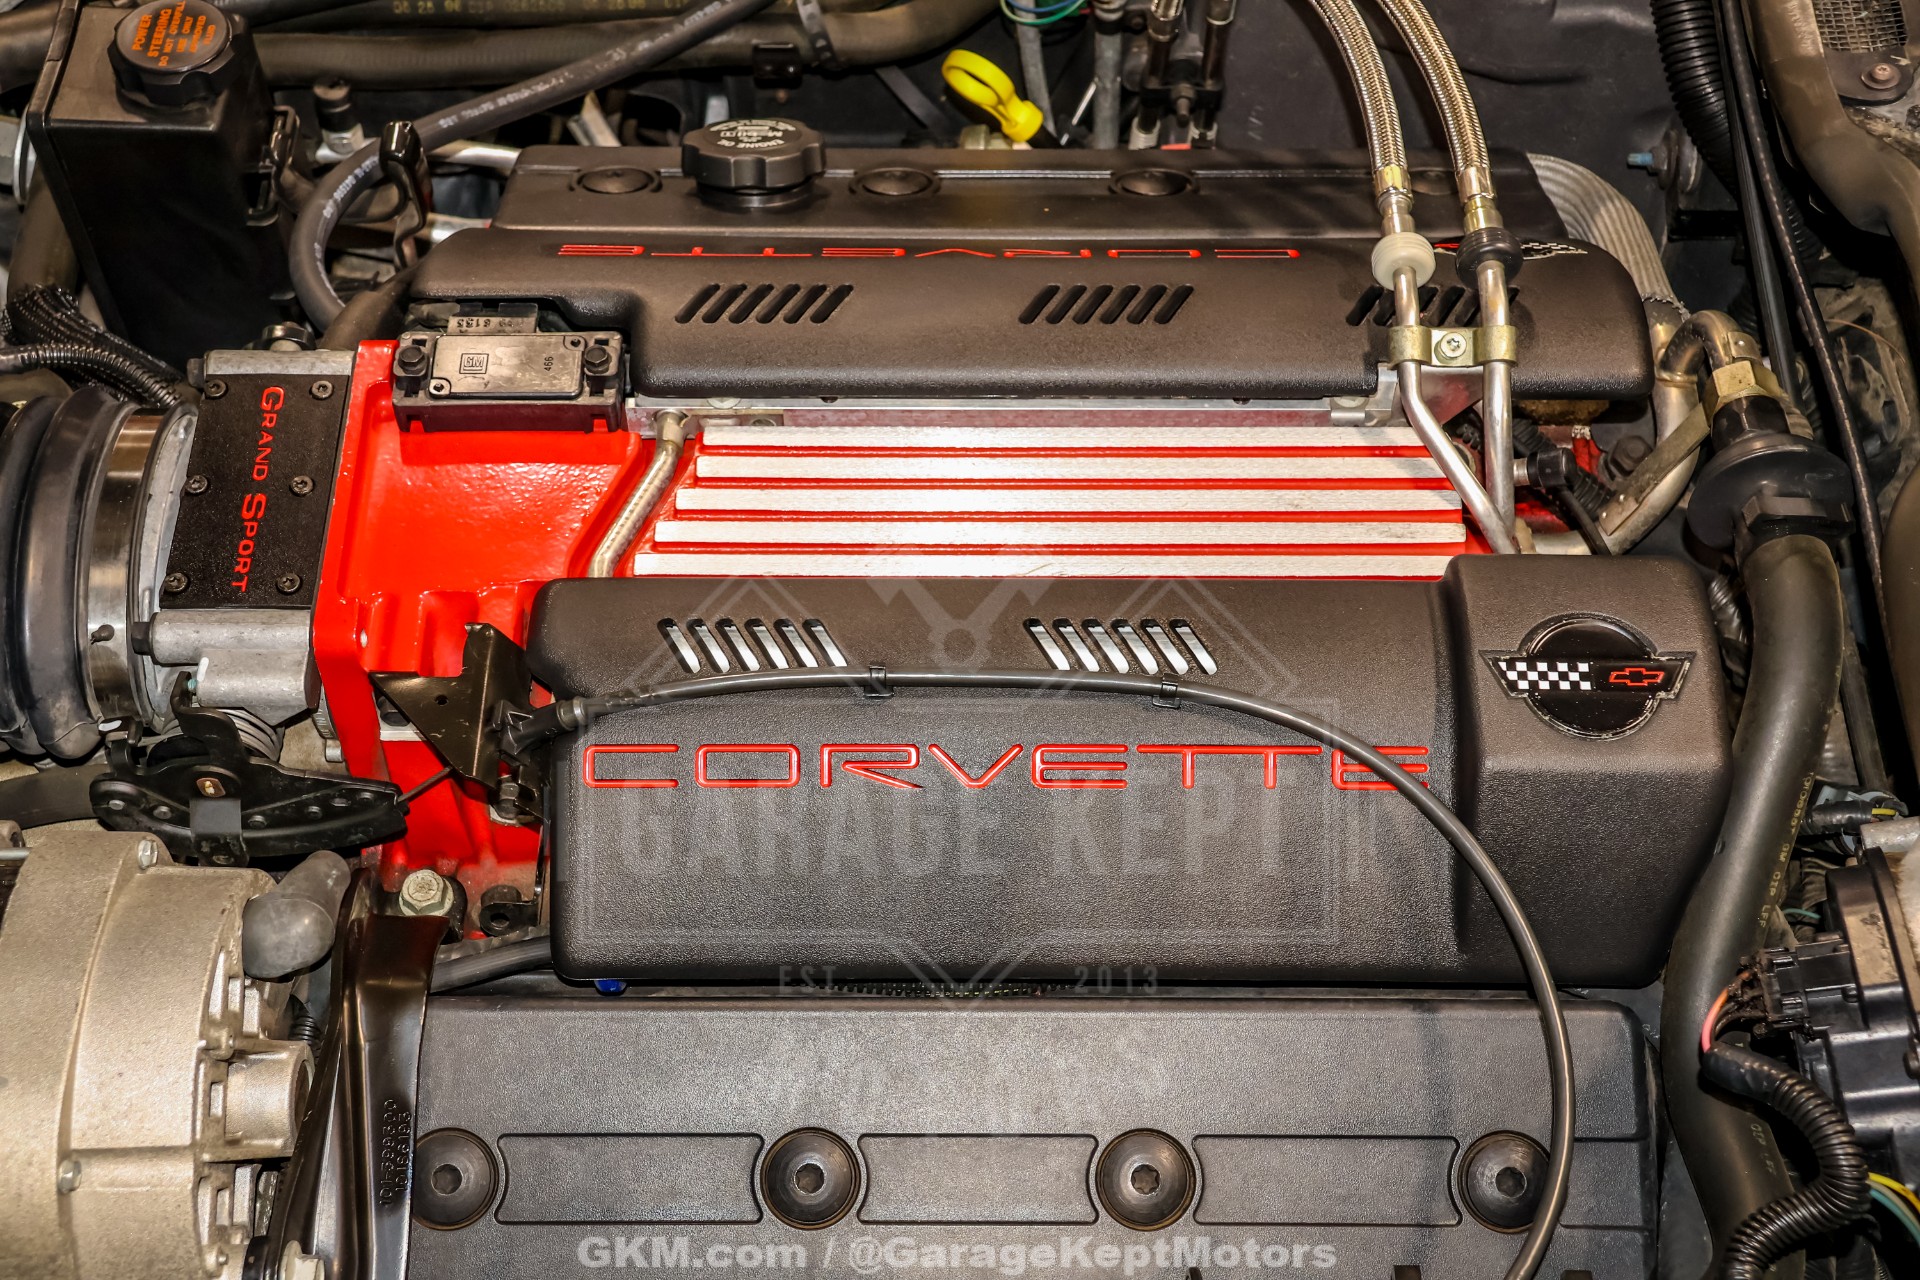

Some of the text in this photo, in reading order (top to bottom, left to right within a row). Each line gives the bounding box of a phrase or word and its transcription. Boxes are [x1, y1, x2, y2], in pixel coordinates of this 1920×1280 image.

[131, 14, 152, 51] POWER
[147, 8, 172, 57] STEERING
[463, 355, 485, 371] GM
[582, 743, 1429, 791] CORVETTE
